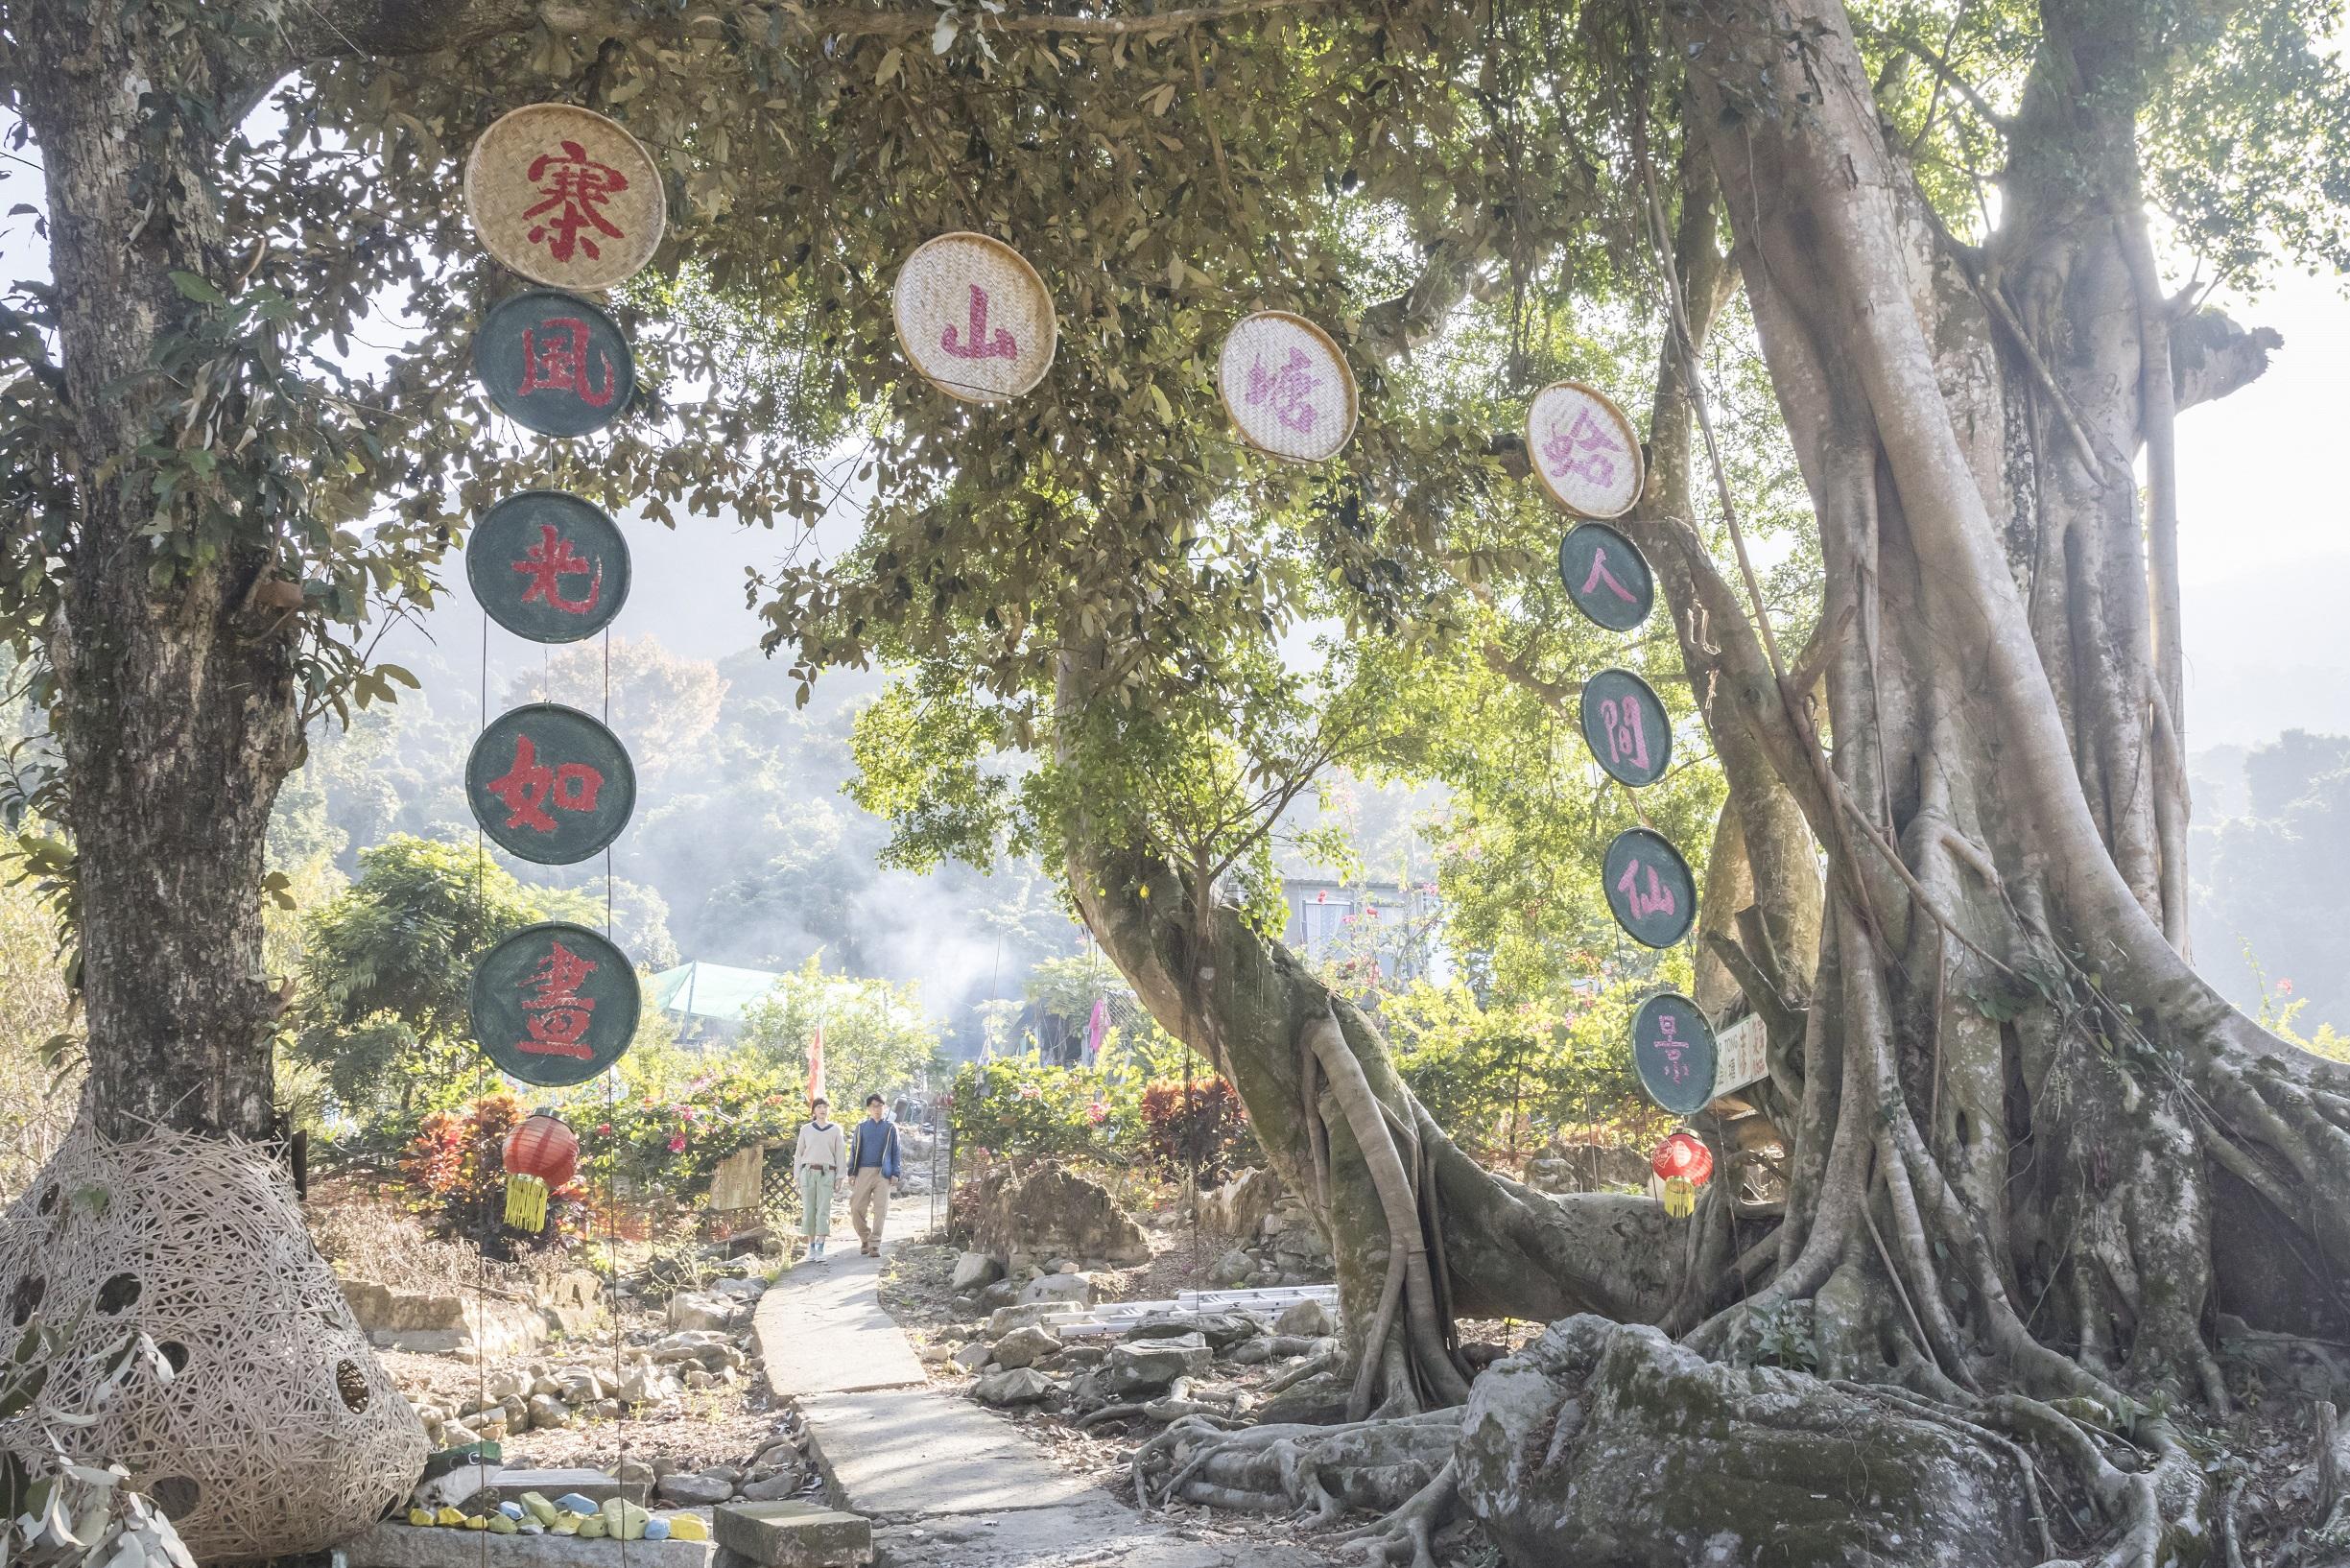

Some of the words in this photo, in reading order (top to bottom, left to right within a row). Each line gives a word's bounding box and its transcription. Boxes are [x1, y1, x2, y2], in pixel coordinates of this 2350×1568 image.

[522, 141, 629, 262] 寨
[940, 284, 1017, 361] 山
[511, 524, 603, 614] 光
[1581, 547, 1637, 603] 人
[1600, 695, 1650, 769] 間
[487, 734, 605, 832] 如
[1618, 860, 1676, 919] 仙
[1653, 1014, 1689, 1084] 景
